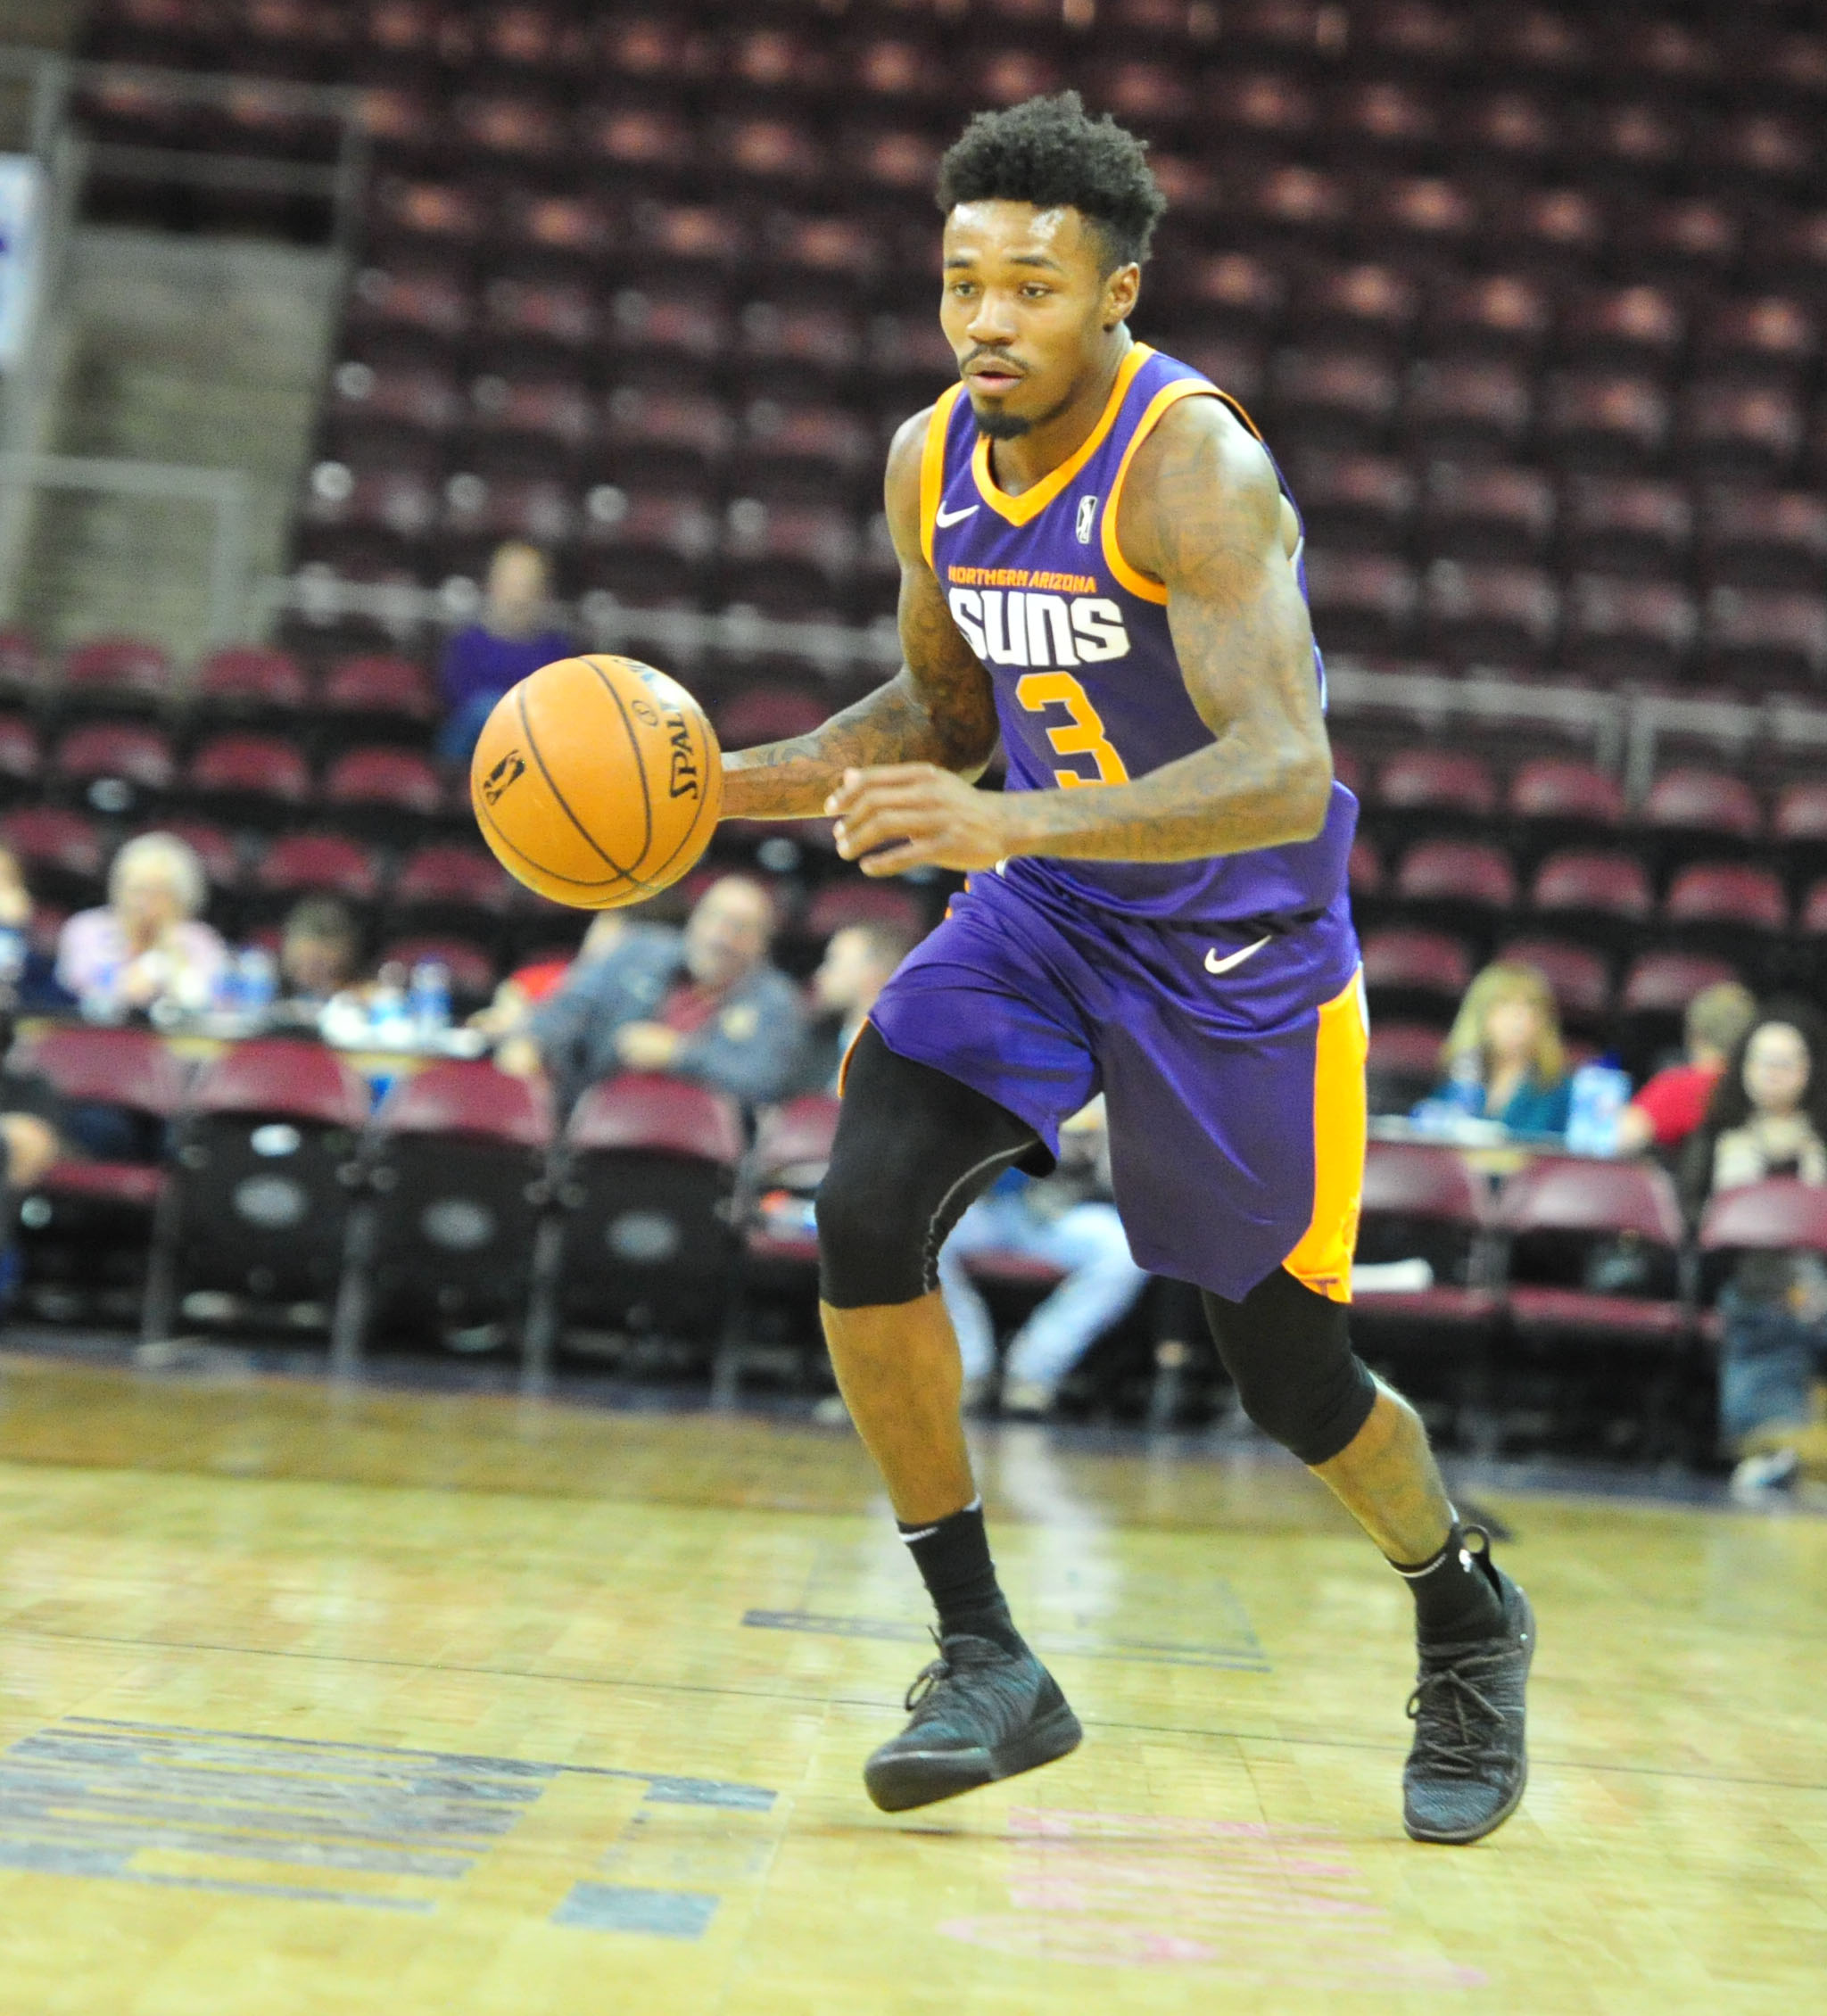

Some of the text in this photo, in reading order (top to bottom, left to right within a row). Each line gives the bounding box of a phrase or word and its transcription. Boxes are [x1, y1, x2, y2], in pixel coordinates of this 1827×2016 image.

[948, 565, 1098, 594] NORTHERN ARIZONA
[948, 586, 1131, 666] SUNS
[1015, 670, 1129, 789] 3
